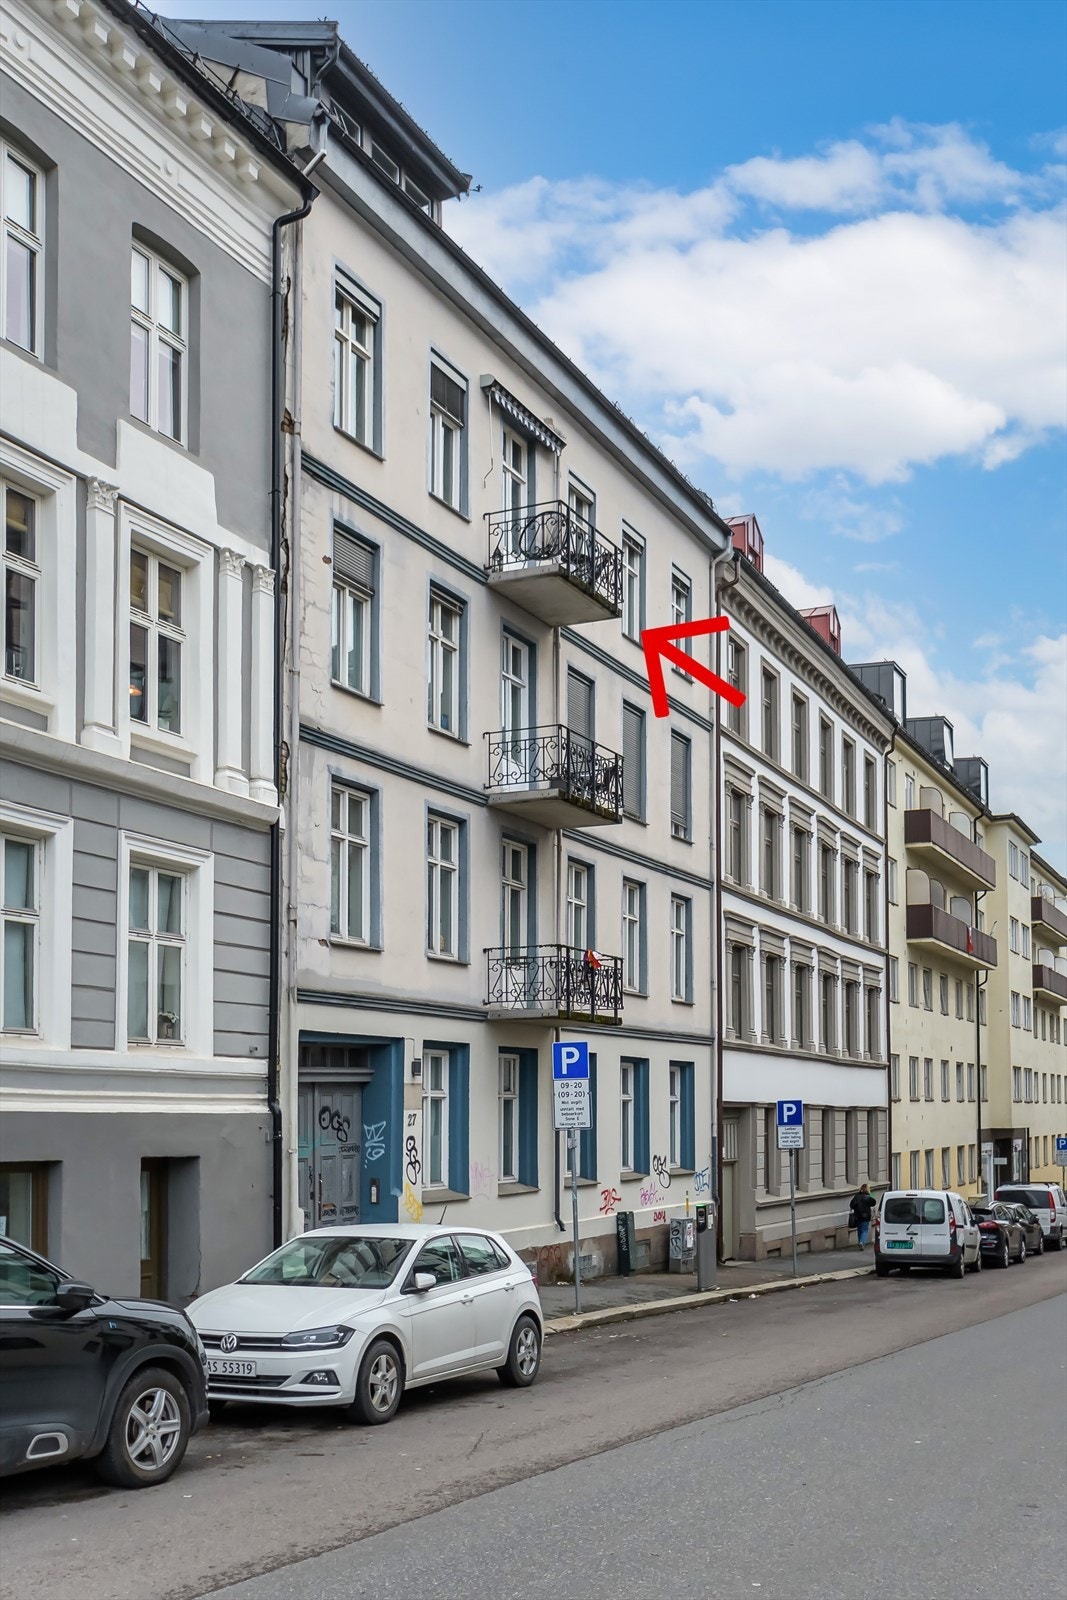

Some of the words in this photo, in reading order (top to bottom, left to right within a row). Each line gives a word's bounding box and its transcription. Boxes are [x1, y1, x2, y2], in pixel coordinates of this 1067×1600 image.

[561, 1047, 580, 1075] P
[557, 1091, 586, 1099] (09-20)
[783, 1103, 797, 1123] P
[407, 1113, 417, 1127] 27
[1058, 1140, 1067, 1149] P
[222, 1362, 253, 1375] 55319
